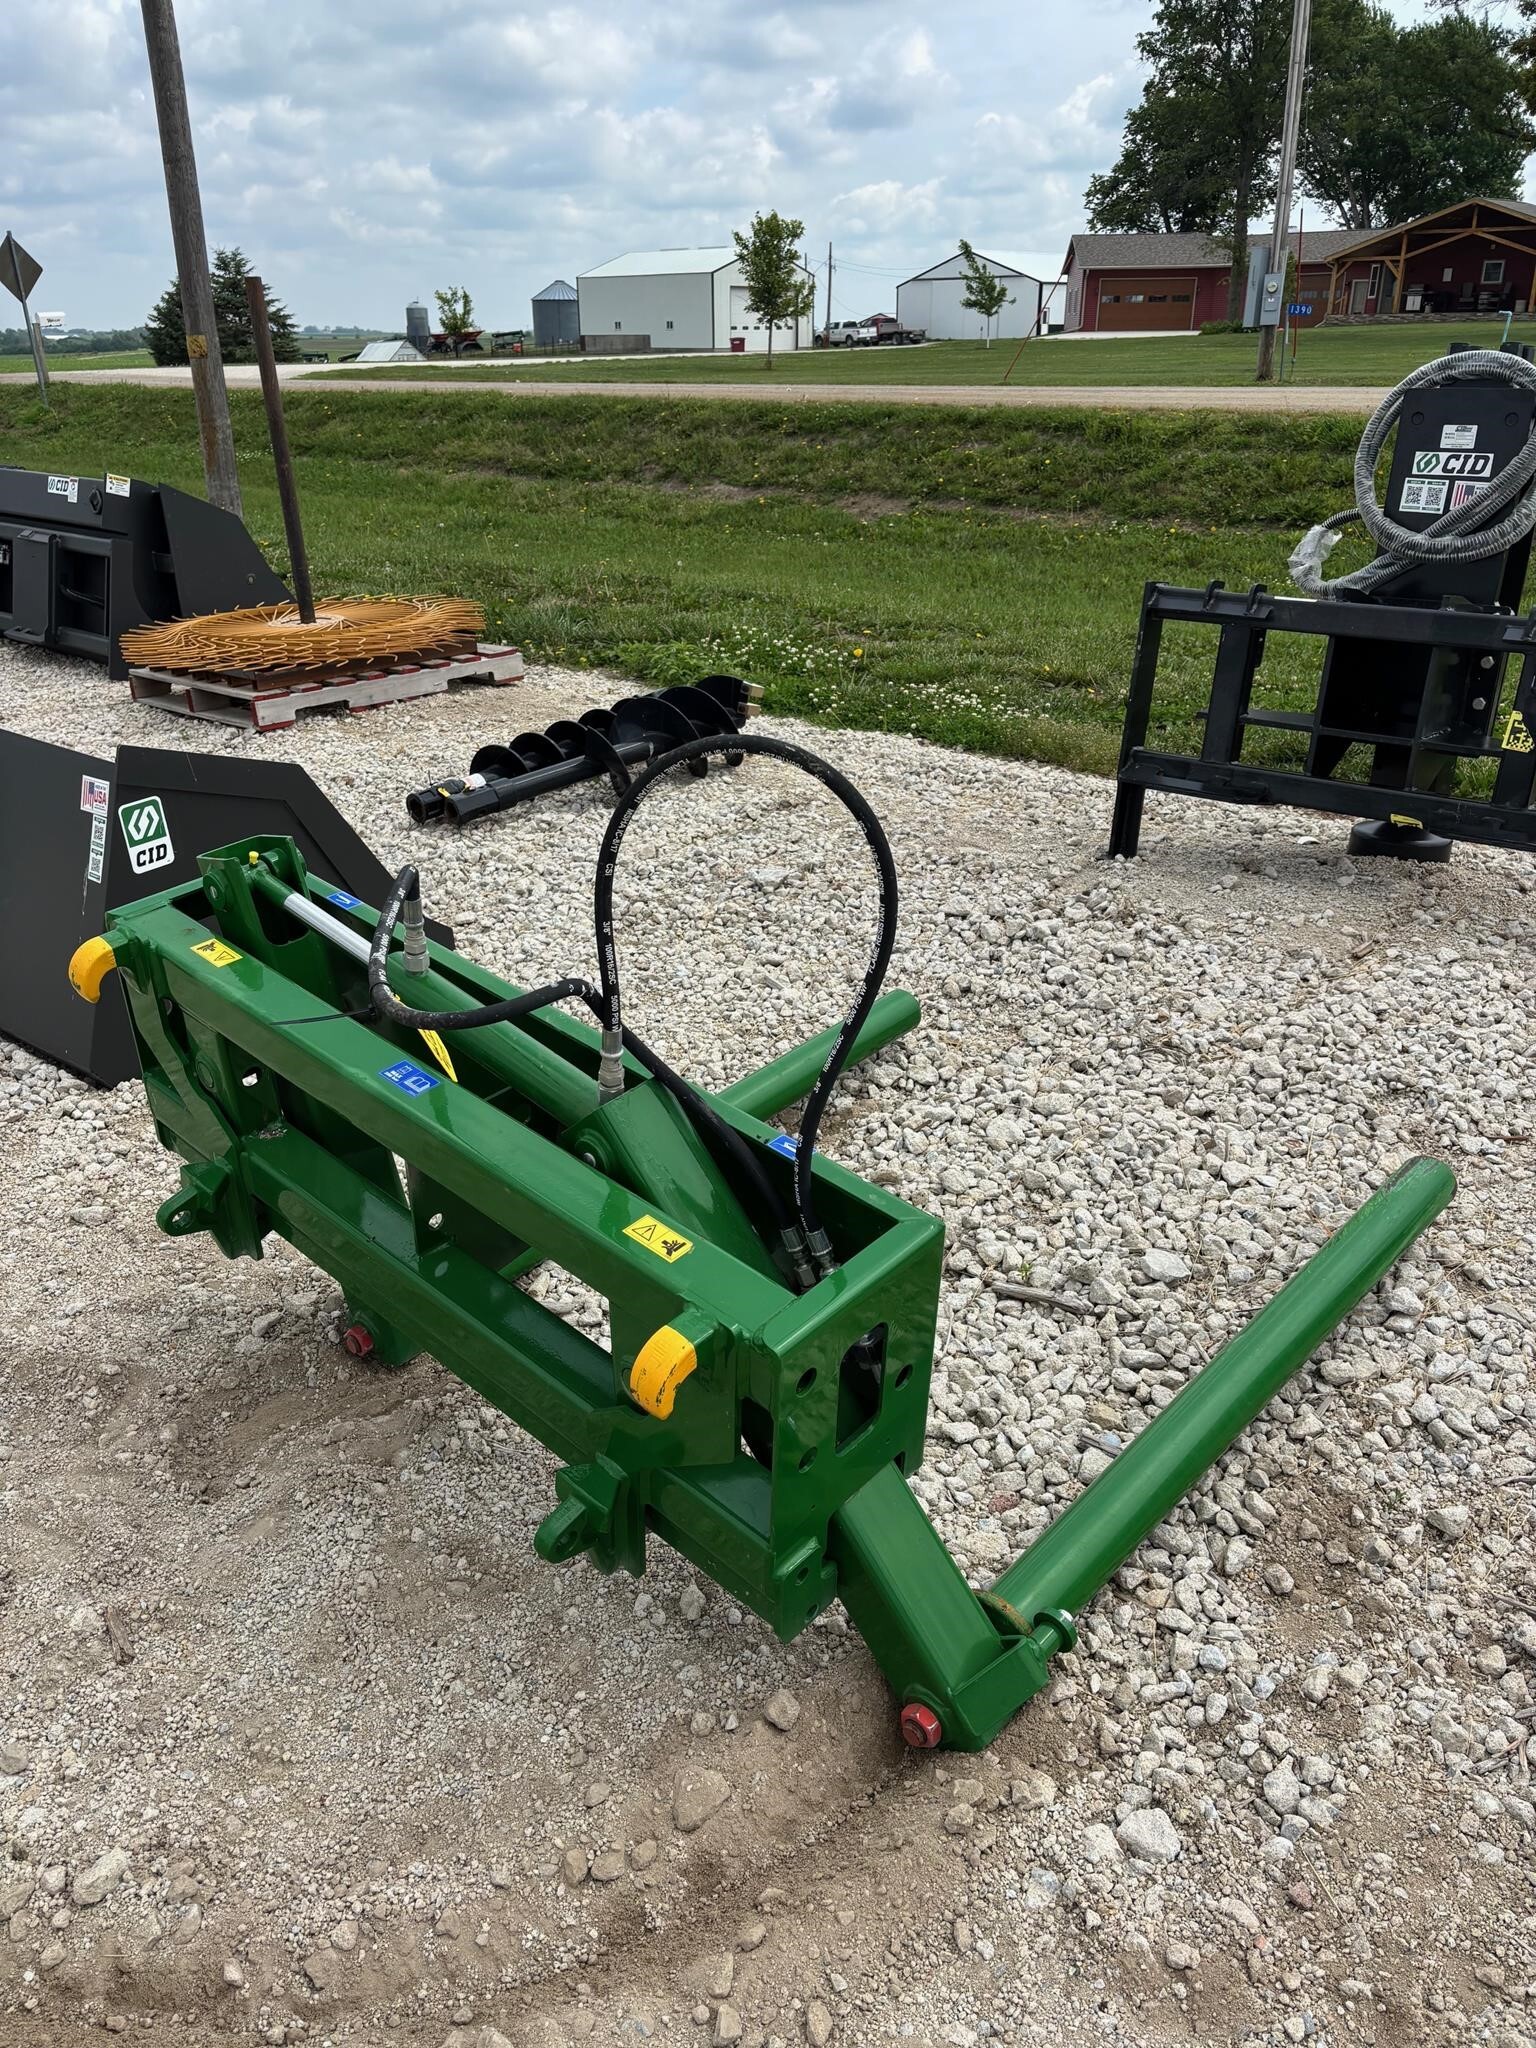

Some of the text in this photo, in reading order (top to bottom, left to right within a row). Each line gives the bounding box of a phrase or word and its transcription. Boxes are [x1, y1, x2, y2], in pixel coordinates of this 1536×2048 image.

[1290, 304, 1312, 315] 1390
[1442, 453, 1491, 475] CID
[55, 479, 69, 492] CID
[634, 772, 667, 804] RESISTANT
[94, 789, 107, 806] USA
[618, 808, 635, 829] MSHA
[136, 843, 167, 868] CID
[604, 863, 614, 876] CSI
[602, 921, 611, 936] 3/8"
[876, 903, 886, 945] RESISTANT
[604, 943, 617, 985] 100R16/2SC
[867, 945, 881, 974] FLAME
[610, 995, 619, 1011] 5000
[854, 995, 864, 1009] PSI
[611, 1012, 619, 1024] PSI
[846, 1007, 857, 1026] 5000
[822, 1033, 845, 1073] 100R16/2SC
[813, 1077, 822, 1094] 3/8"
